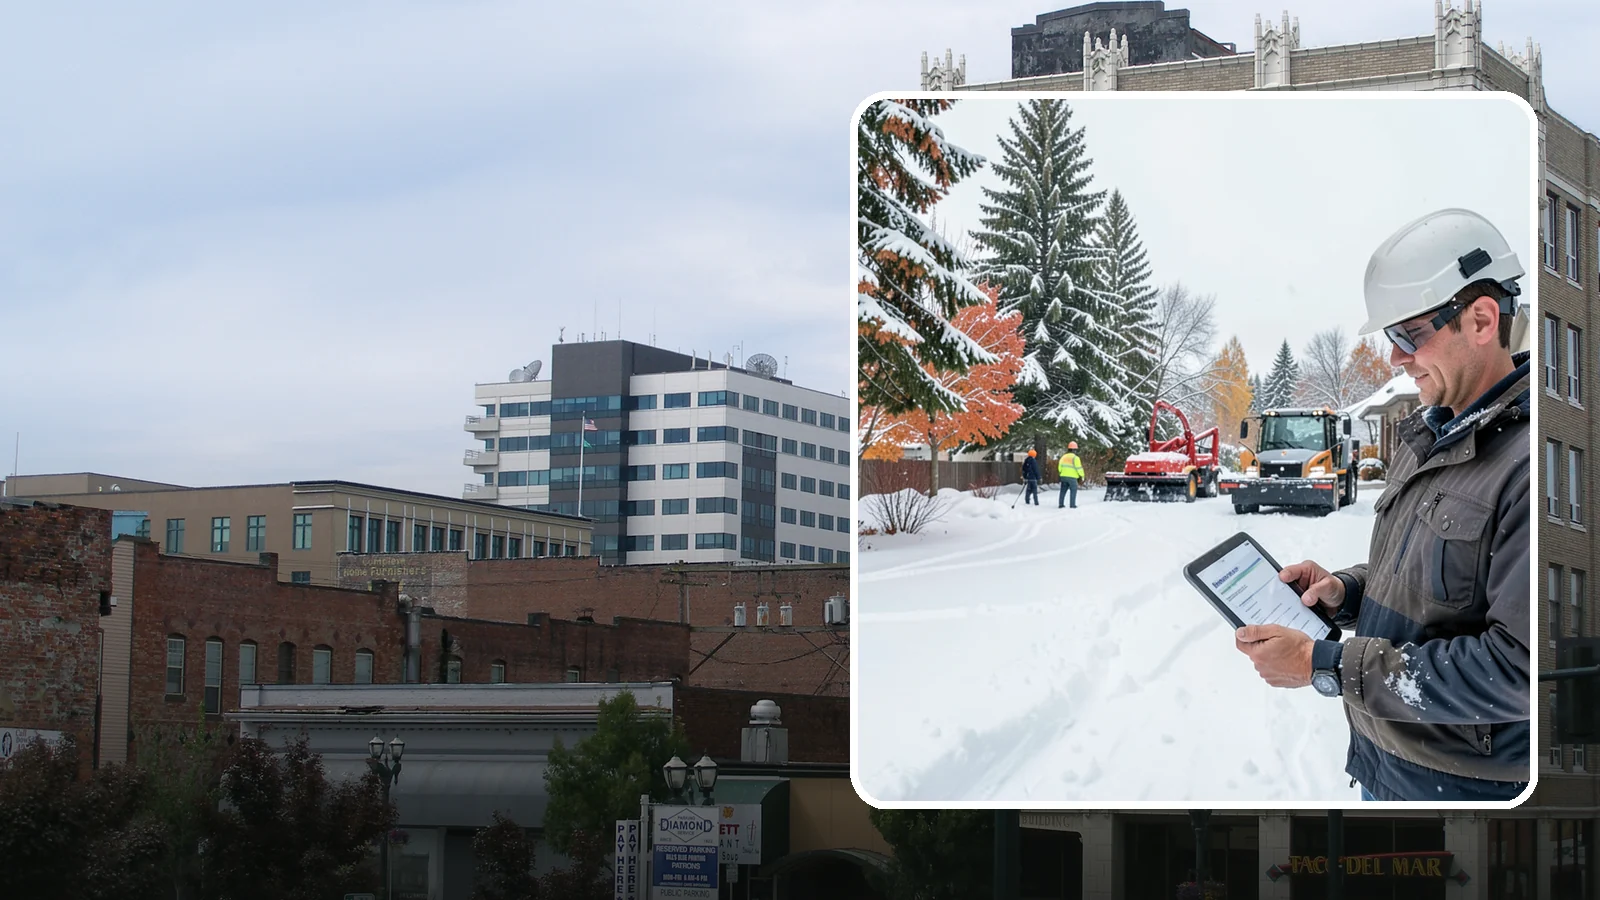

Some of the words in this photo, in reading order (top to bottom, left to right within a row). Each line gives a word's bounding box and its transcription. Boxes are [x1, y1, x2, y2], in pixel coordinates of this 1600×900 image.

[370, 566, 427, 576] Furnishers
[660, 818, 713, 833] DIAMOND
[1022, 815, 1070, 828] BUILDING
[719, 824, 740, 835] ETT
[617, 825, 625, 853] PAY
[628, 824, 637, 853] PAY
[656, 845, 688, 853] RESERVED
[689, 846, 716, 854] PARKING
[721, 851, 739, 862] Soup
[672, 862, 701, 870] PATRONS
[1289, 855, 1330, 874] TAC
[1345, 856, 1385, 875] DEL
[1391, 857, 1443, 876] MAR
[616, 856, 625, 894] HERE
[627, 855, 636, 894] HERE
[660, 888, 682, 897] PUBLIC
[684, 889, 710, 898] PARKING
